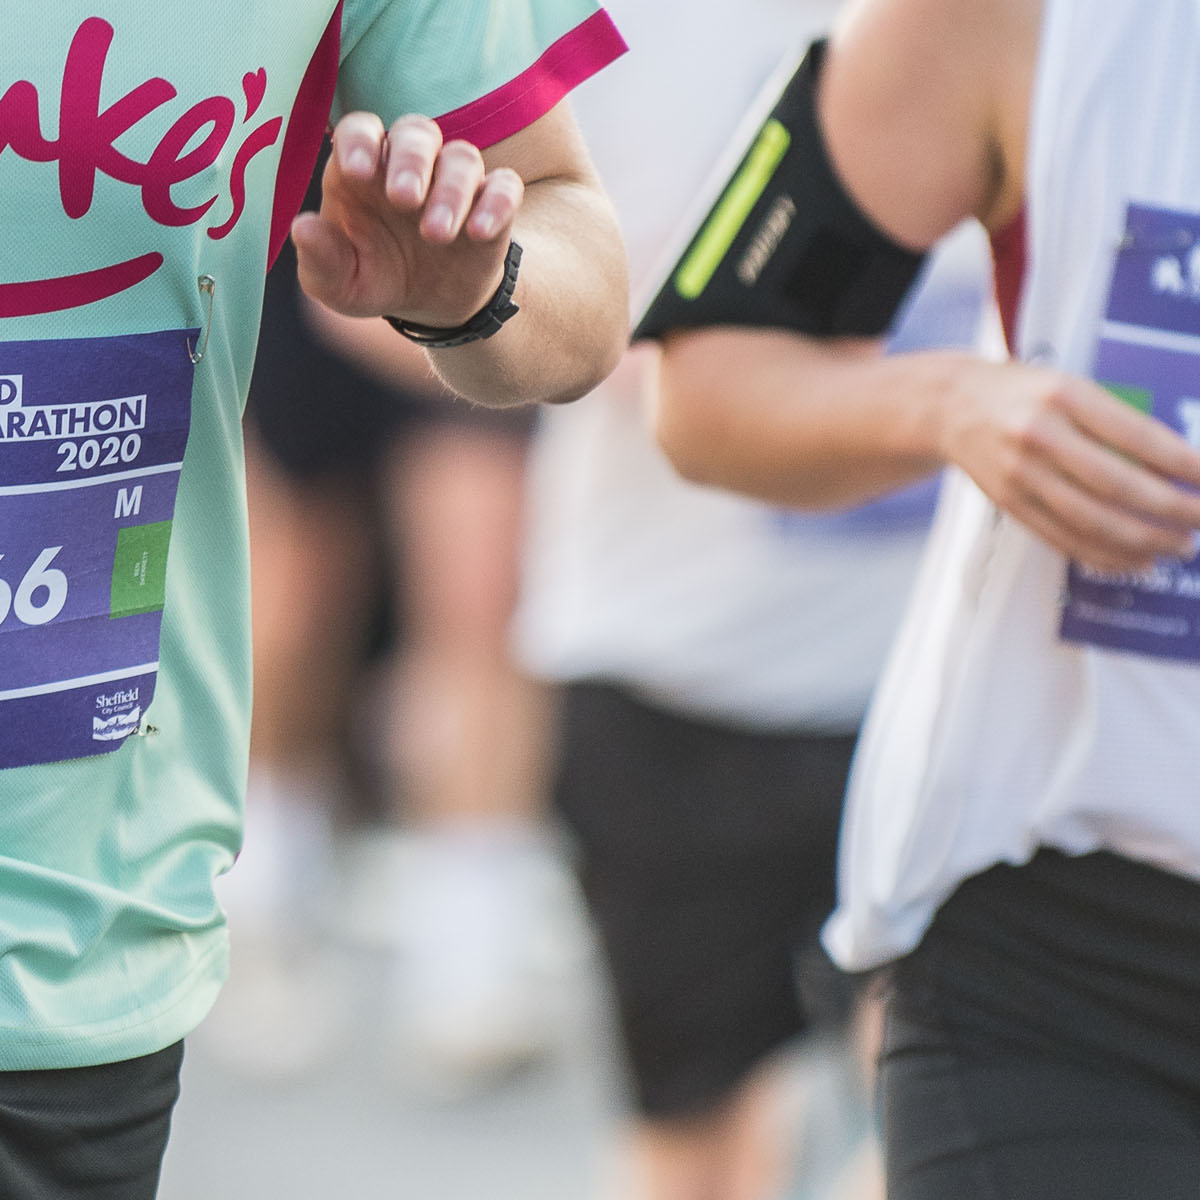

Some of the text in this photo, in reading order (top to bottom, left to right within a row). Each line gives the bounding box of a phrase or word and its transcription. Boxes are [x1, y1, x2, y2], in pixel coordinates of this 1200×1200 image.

[56, 433, 142, 472] 2020
[113, 485, 143, 518] M
[95, 687, 139, 709] Sheffield
